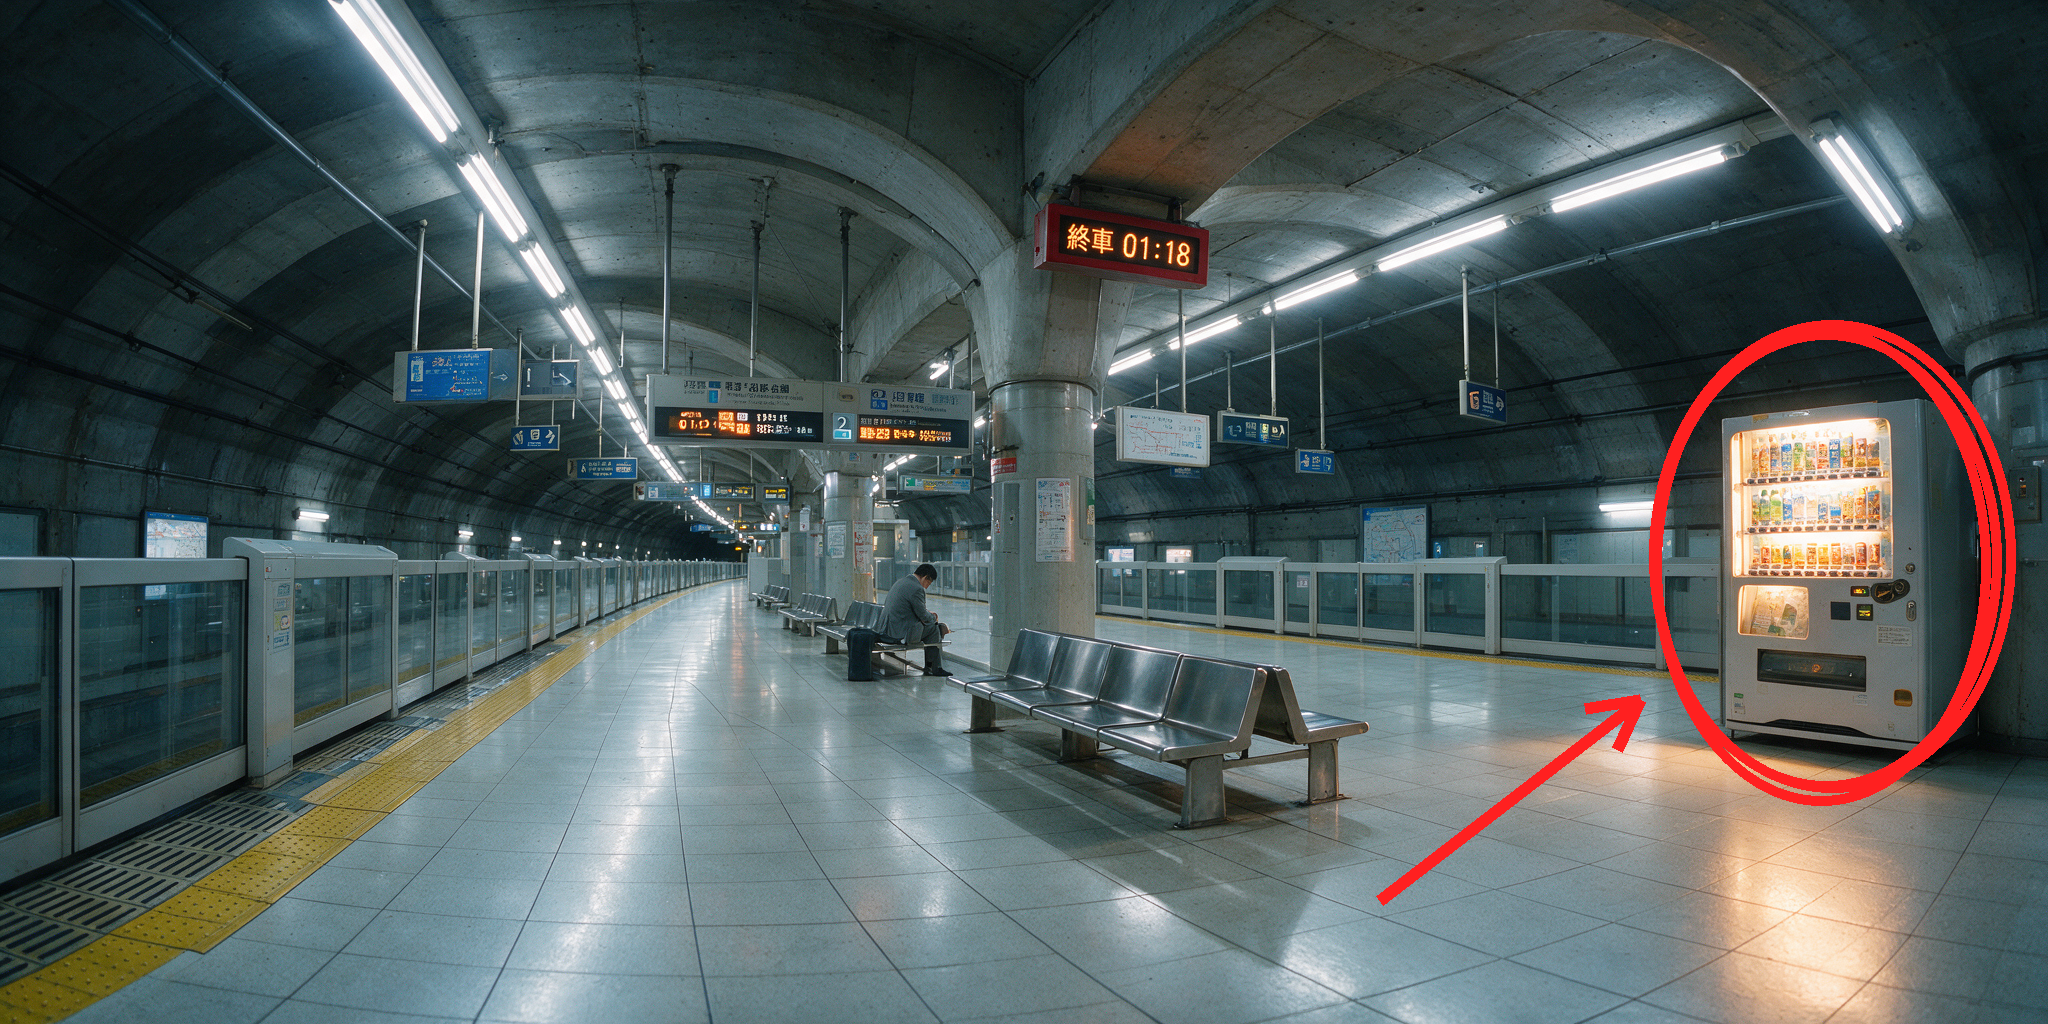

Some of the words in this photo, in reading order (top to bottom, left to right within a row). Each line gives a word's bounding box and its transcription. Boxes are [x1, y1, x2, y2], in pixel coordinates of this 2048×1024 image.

[1066, 223, 1115, 255] 終車
[1122, 232, 1191, 268] 01:18
[837, 416, 847, 429] 2
